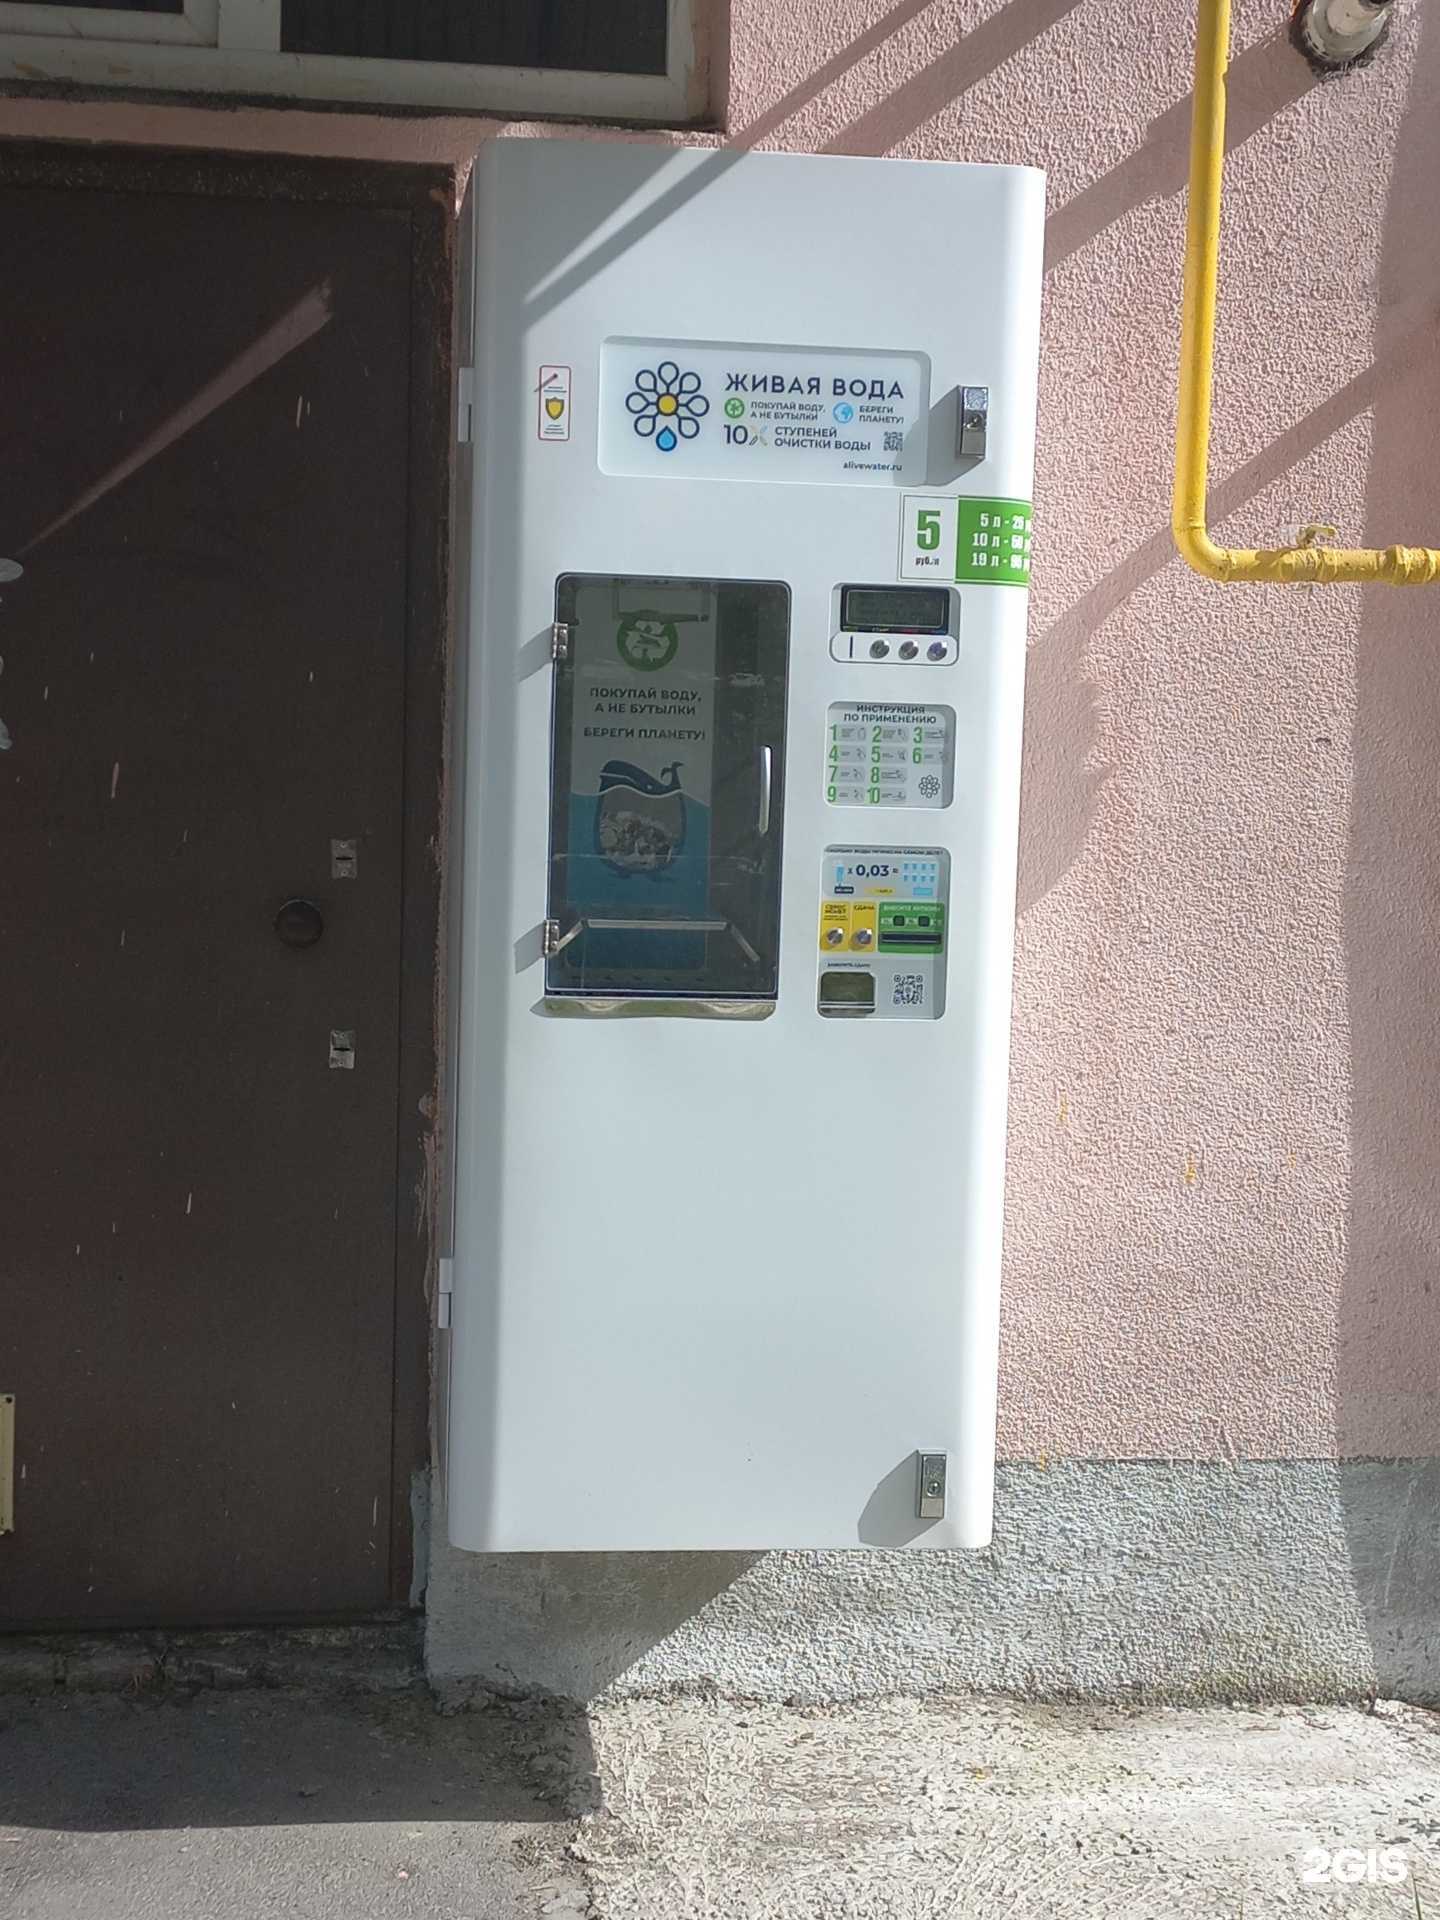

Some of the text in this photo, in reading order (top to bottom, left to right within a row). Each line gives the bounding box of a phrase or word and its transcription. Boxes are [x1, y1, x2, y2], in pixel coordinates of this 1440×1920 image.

[725, 373, 904, 400] ЖИВАЯ ВОДА
[751, 401, 826, 413] ПОКУПАЙ ВОДУ,
[859, 405, 893, 414] БЕРЕГИ
[774, 412, 818, 421] БУТЫЛКИ
[775, 426, 837, 438] СТУПЕНЕЙ
[775, 438, 871, 451] ОЧИСТКИ ВОДЫ
[843, 461, 902, 471] alivewater.ru
[980, 513, 989, 527] 5
[992, 516, 1000, 528] л
[917, 510, 941, 550] 5
[972, 533, 988, 546] 10
[992, 536, 1000, 547] л
[991, 555, 999, 567] л
[590, 687, 701, 702] ПОКУПАЙ ВОДУ,
[594, 703, 696, 715] А НЕ БУТЫЛКИ
[856, 704, 925, 714] ИНСТРУКЦИЯ
[844, 713, 937, 724] ПО ПРИМЕНЕНИЮ
[584, 727, 705, 740] БЕРЕГИ ПЛАНЕТУ!
[829, 724, 837, 741] 1
[872, 725, 881, 743] 2
[913, 726, 922, 743] 3
[829, 745, 838, 761] 4
[871, 746, 880, 763] 5
[912, 747, 922, 764] 6
[828, 765, 838, 782] 7
[871, 766, 880, 783] 8
[827, 785, 837, 802] 9
[867, 787, 880, 804] 10
[856, 864, 889, 877] 0,03
